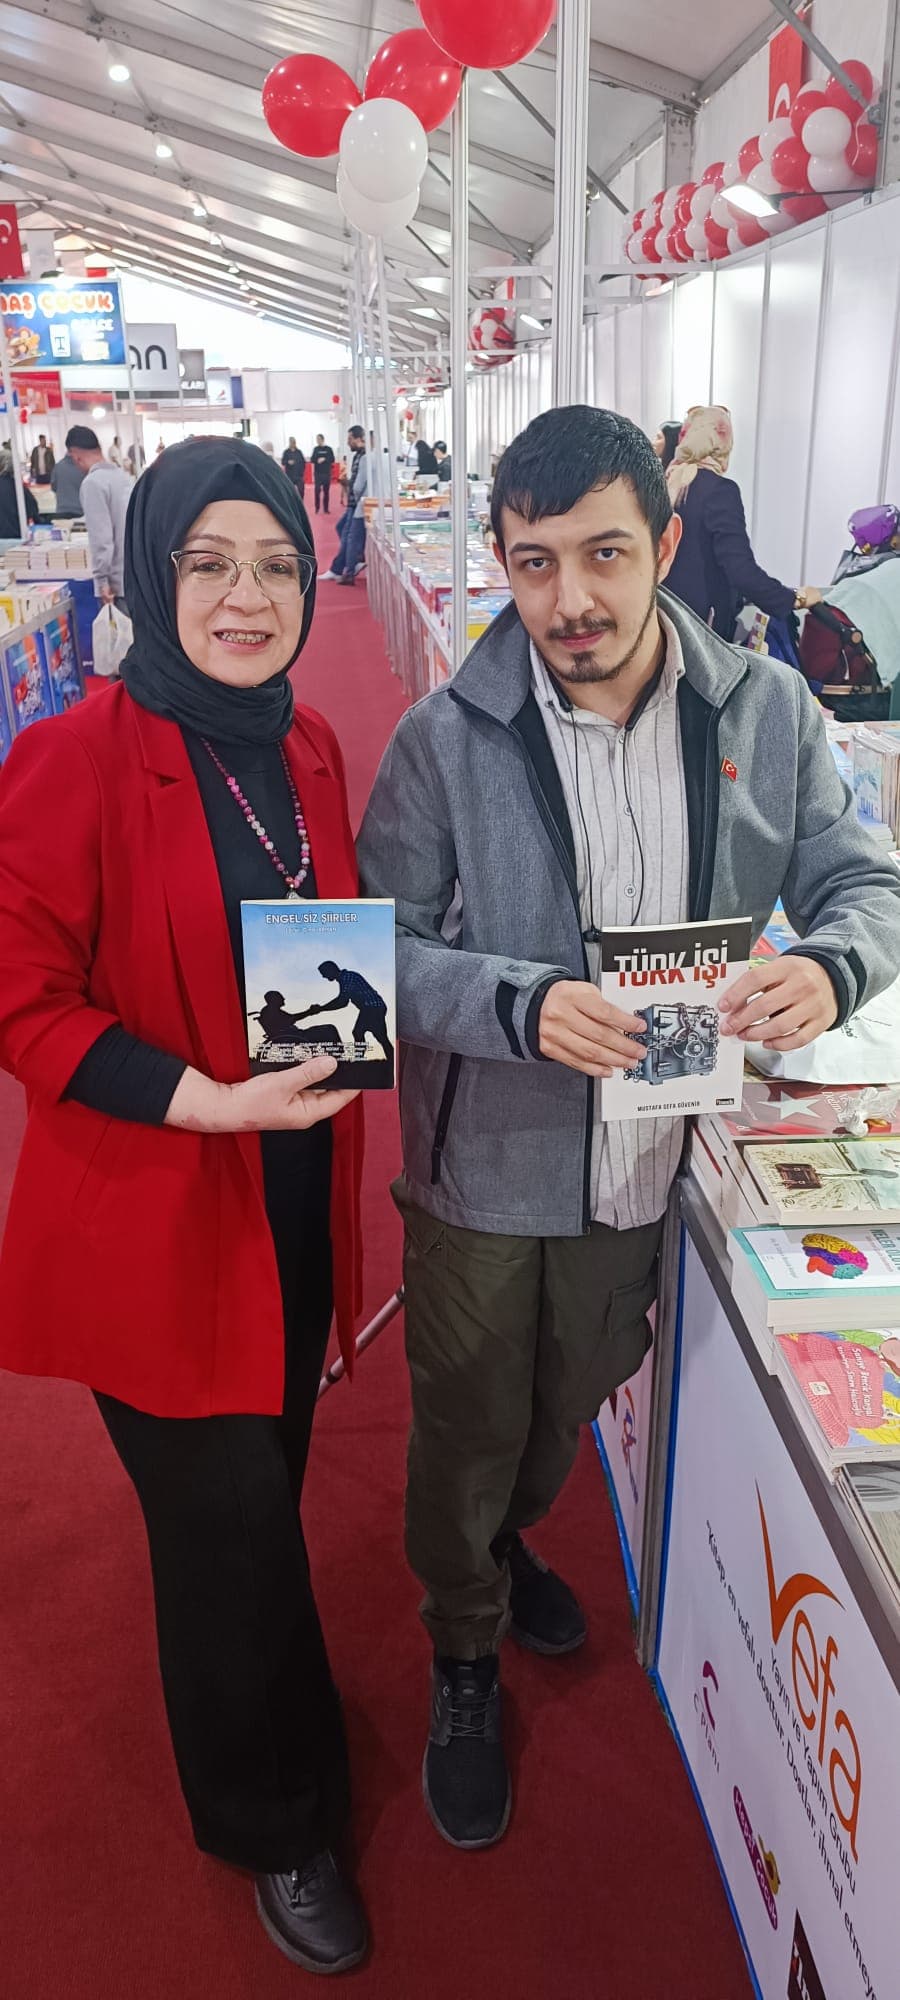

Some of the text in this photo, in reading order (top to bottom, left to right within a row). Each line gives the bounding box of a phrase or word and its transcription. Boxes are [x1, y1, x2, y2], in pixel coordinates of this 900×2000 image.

[40, 293, 112, 317] ÇOCUK
[266, 914, 301, 924] ENGEL
[303, 911, 318, 923] SİZ
[614, 938, 728, 989] TÜRK İŞİ
[637, 1103, 662, 1112] MUSTAFA
[755, 1478, 861, 1865] Vefa
[727, 1585, 737, 1612] en
[737, 1607, 756, 1665] vefalı
[786, 1738, 816, 1838] Dostlar,
[818, 1828, 844, 1909] ihmal
[771, 1647, 856, 1896] Yayın ve Yapım Grubu
